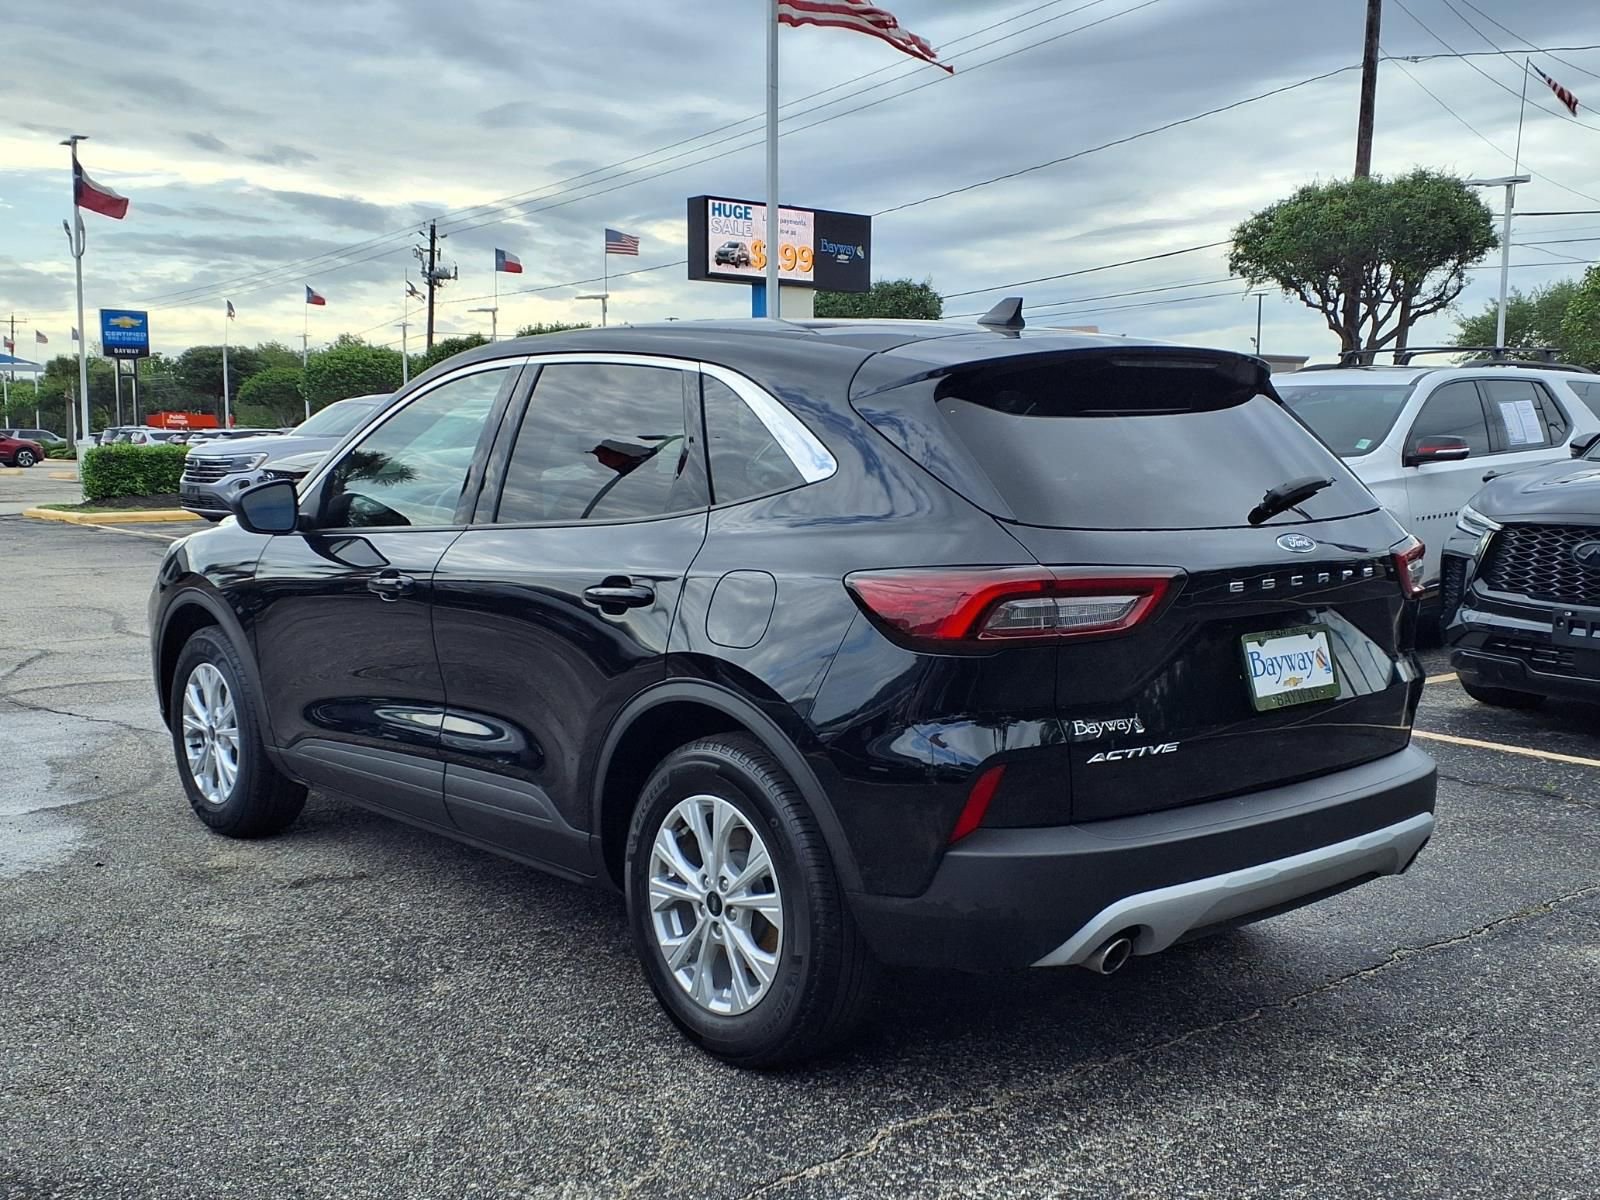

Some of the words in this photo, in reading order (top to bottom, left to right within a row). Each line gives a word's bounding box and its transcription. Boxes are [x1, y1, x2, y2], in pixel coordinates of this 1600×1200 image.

[711, 202, 753, 220] HUGE
[711, 218, 753, 237] SALE
[820, 238, 857, 258] Bayway
[1287, 535, 1310, 548] Ford
[1229, 567, 1373, 593] ESCAPE
[1248, 650, 1315, 684] Bayway
[1072, 718, 1134, 738] Bayway
[1086, 741, 1181, 764] ACTIVE
